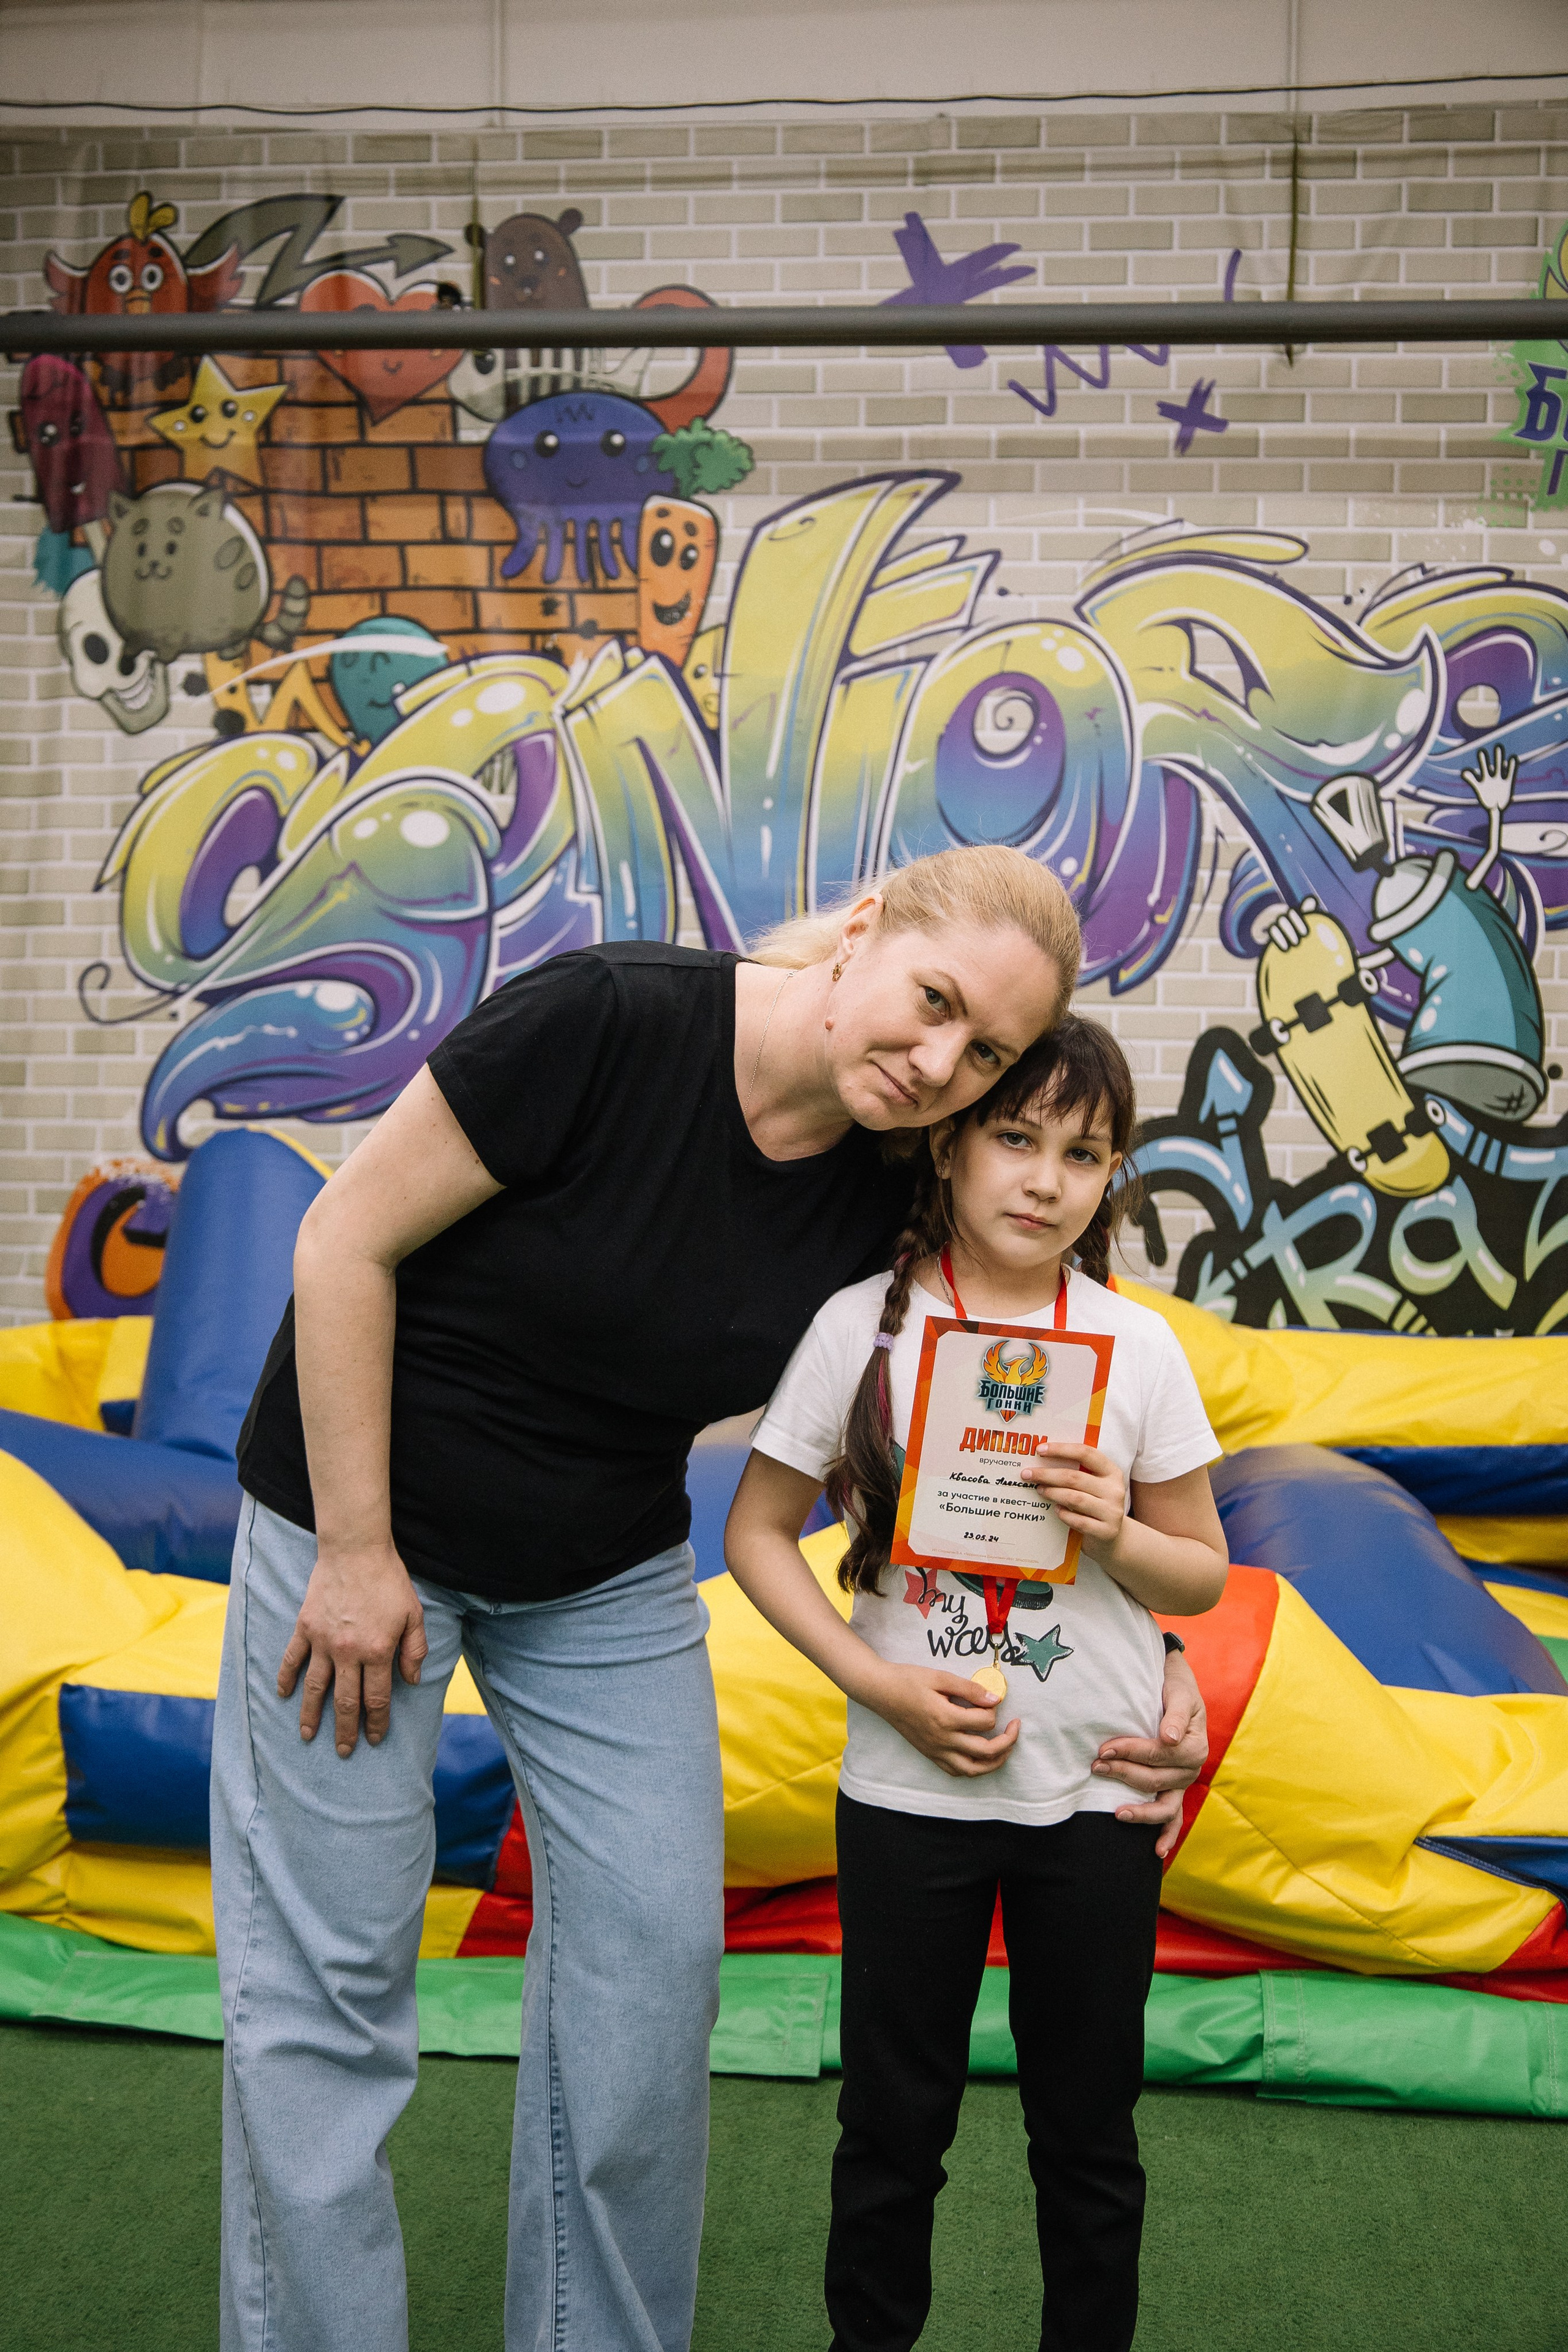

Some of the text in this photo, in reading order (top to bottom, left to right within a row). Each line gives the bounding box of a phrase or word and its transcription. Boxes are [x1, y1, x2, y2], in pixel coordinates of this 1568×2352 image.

[978, 1379, 1046, 1404] БОЛЬШИЕ
[987, 1398, 1032, 1414] ГОНКИ
[959, 1427, 1048, 1456] ДИПЛОМ
[979, 1458, 1021, 1467] вручается
[949, 1472, 990, 1484] Квасова
[951, 1491, 990, 1502] участие
[1000, 1498, 1052, 1510] квест-шоу
[939, 1502, 1046, 1522] «Большие гонки»
[963, 1531, 1000, 1542] 23.05.24
